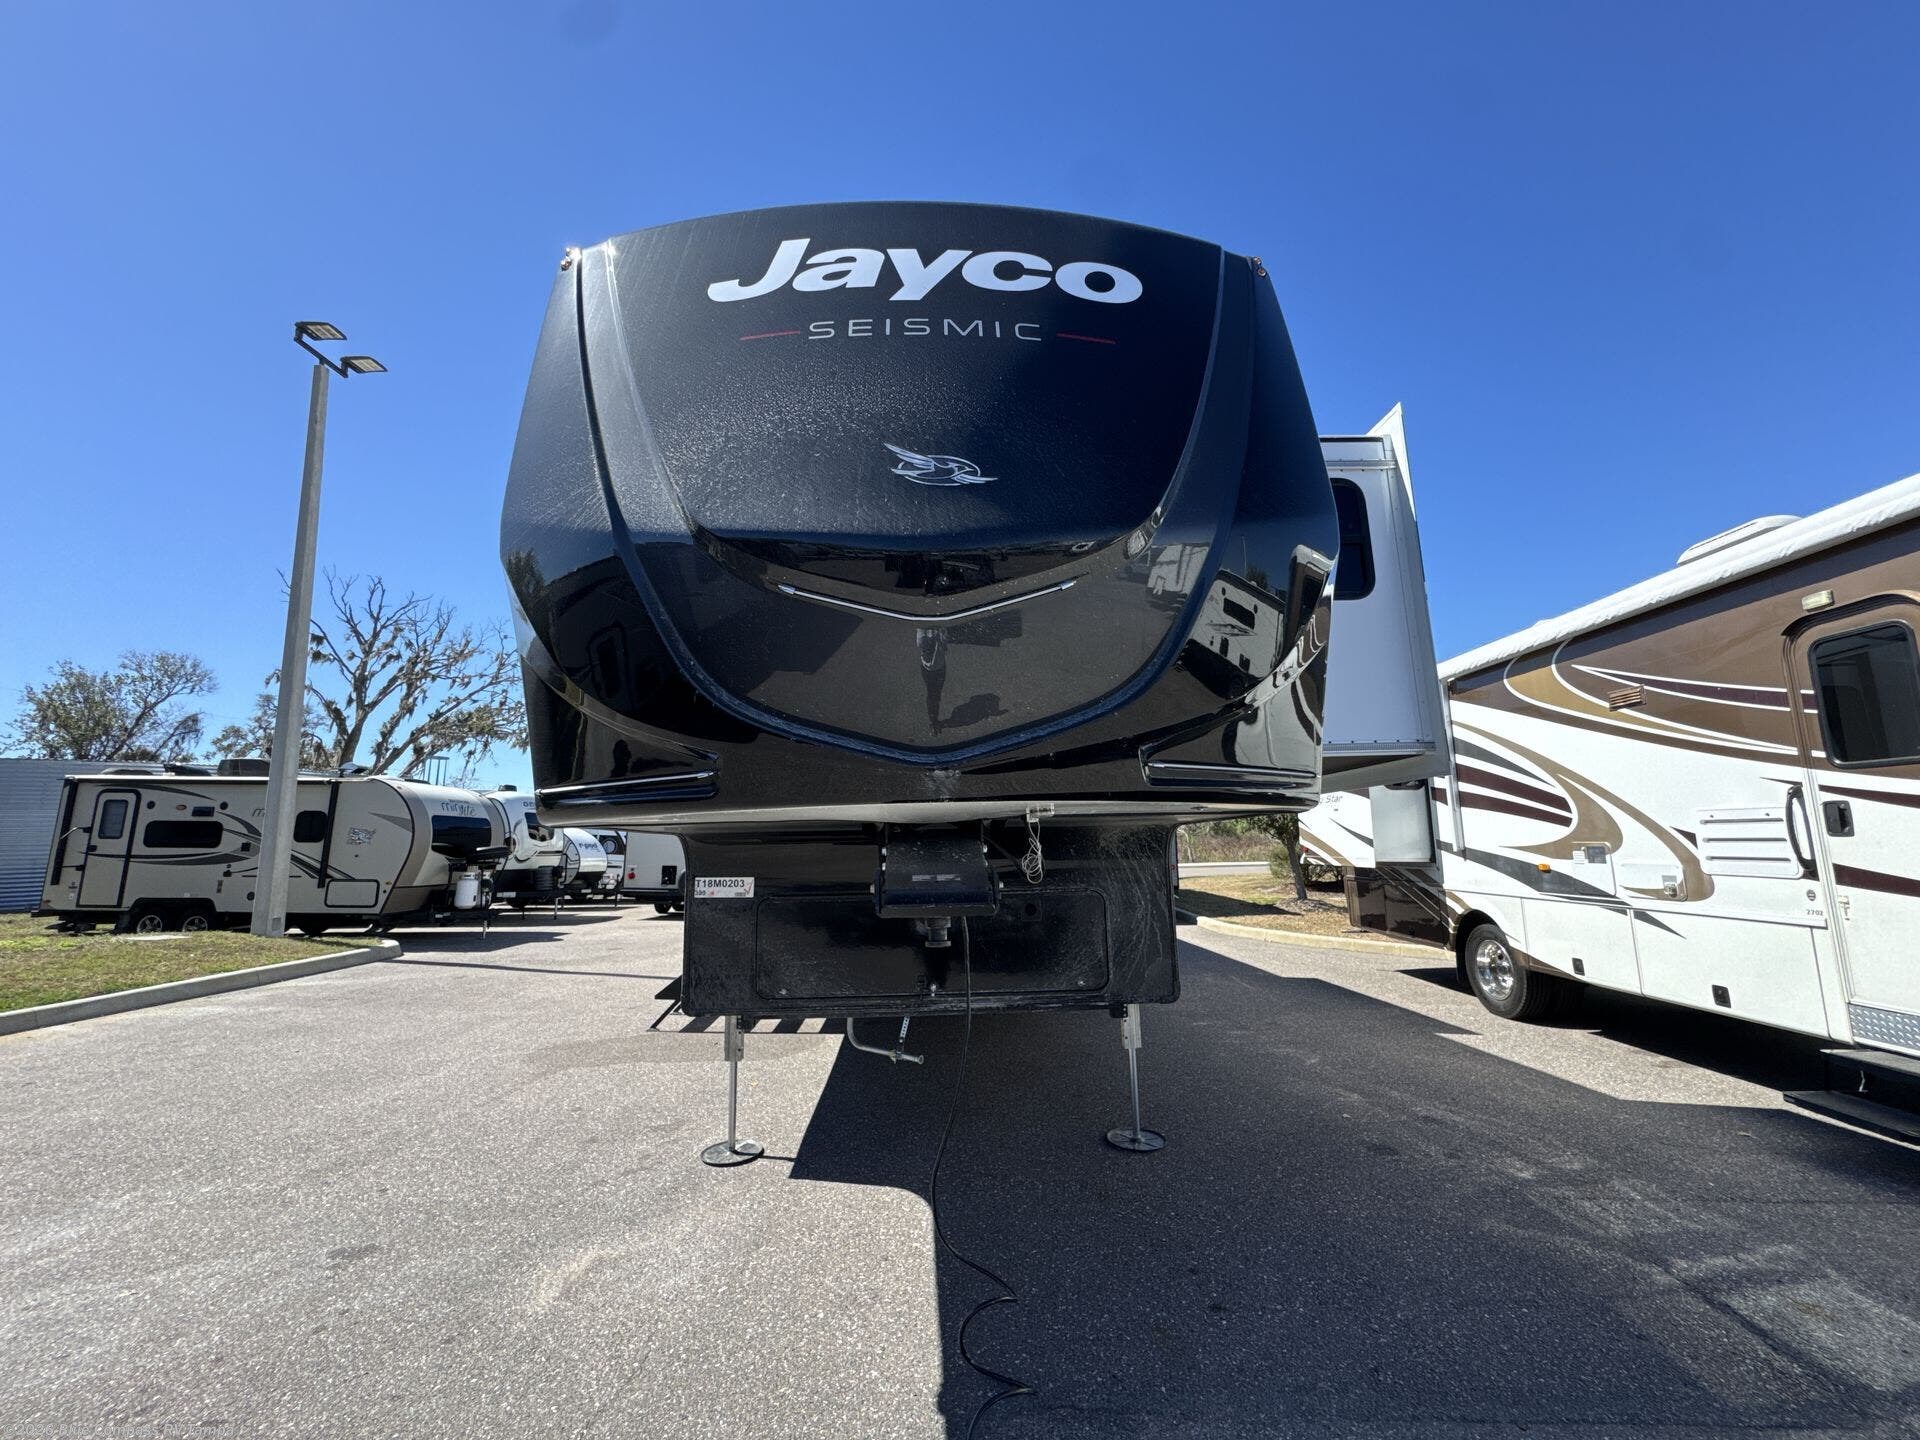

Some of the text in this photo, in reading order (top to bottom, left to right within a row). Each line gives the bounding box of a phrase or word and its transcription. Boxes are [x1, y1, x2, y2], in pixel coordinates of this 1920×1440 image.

[707, 237, 1144, 304] Jayco
[808, 317, 1042, 342] SEISMIC
[695, 879, 745, 888] T18M0203
